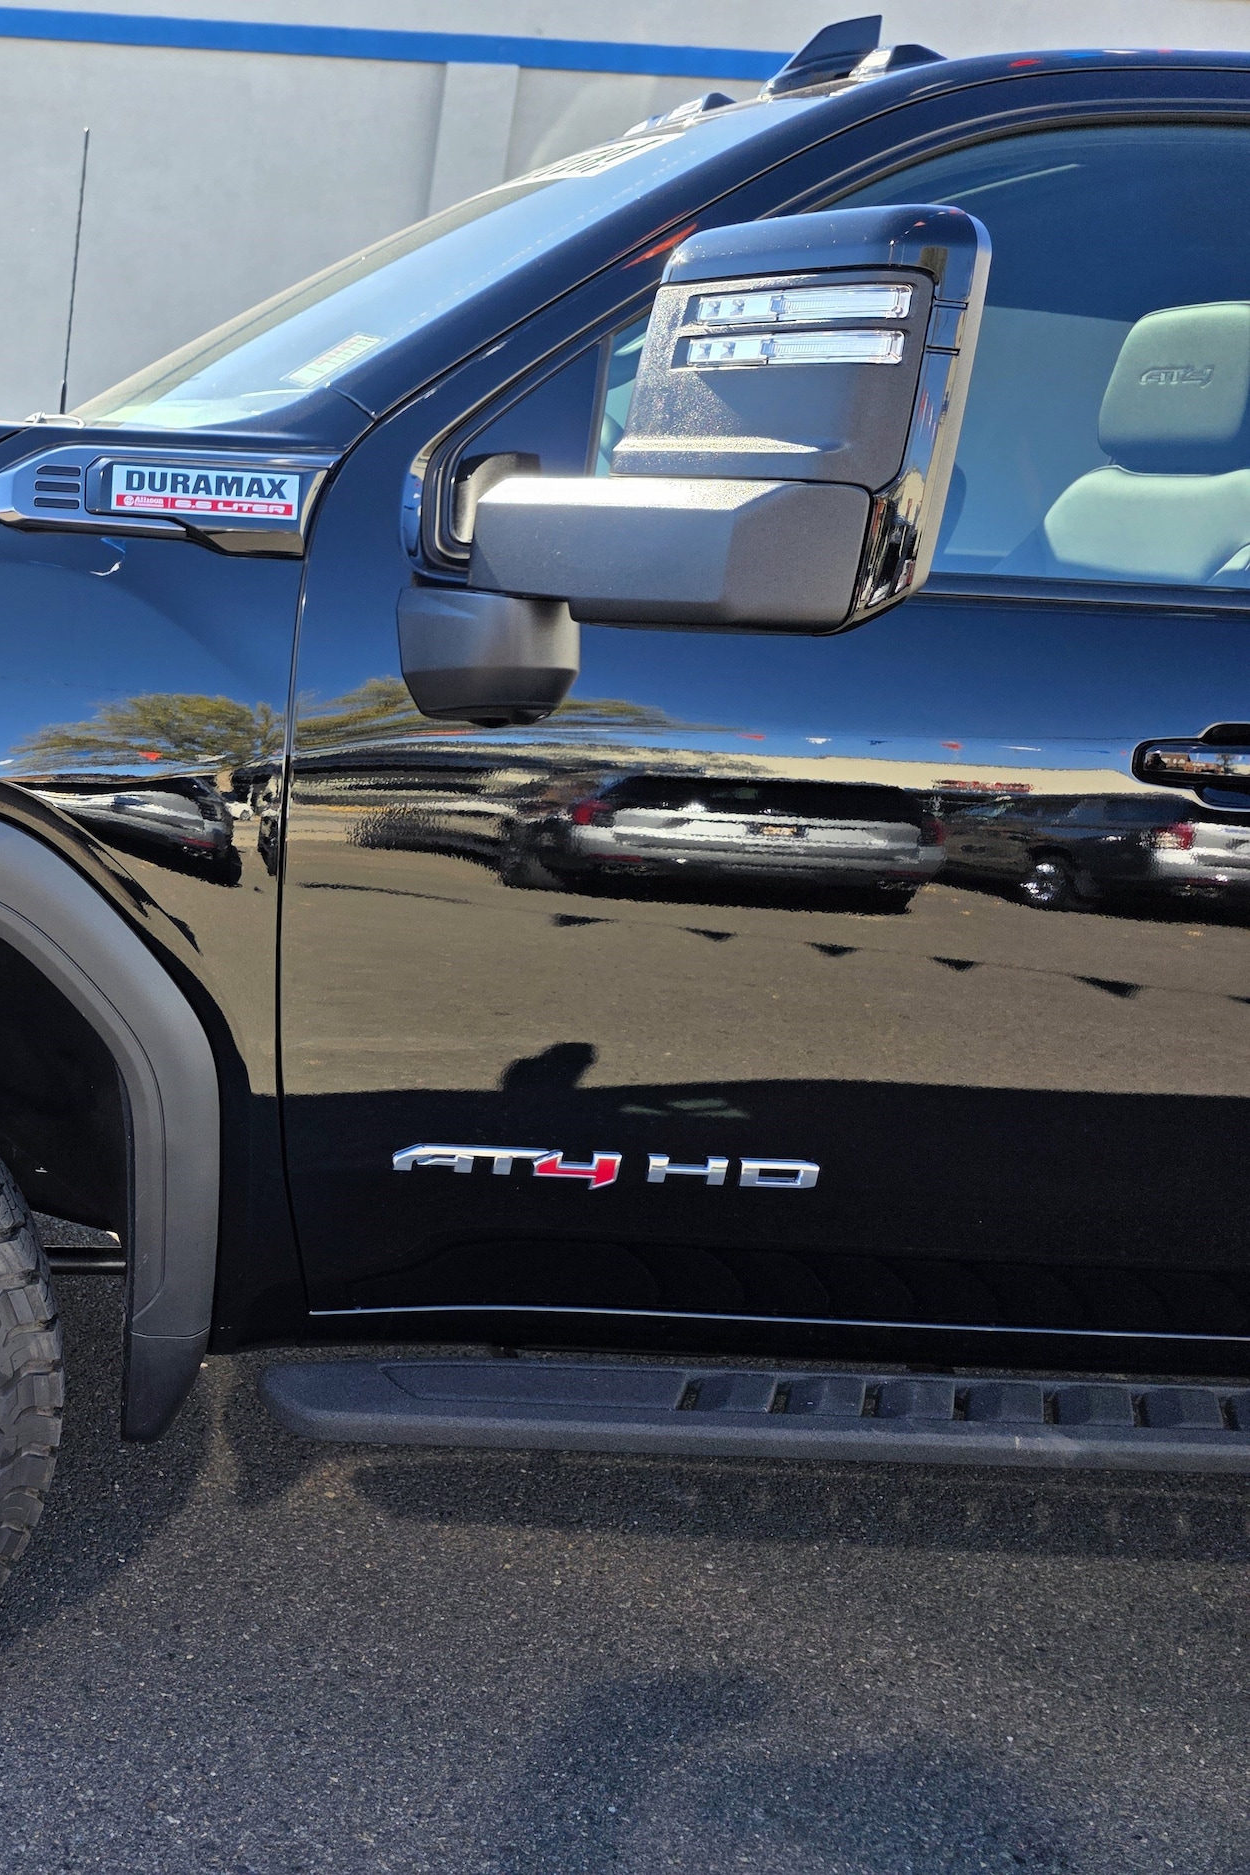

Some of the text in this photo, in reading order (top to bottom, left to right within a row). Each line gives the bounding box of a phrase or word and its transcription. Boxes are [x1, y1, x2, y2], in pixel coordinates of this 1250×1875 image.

[1139, 364, 1215, 388] AT4
[125, 470, 288, 499] DURAMAX
[175, 500, 213, 510] 6.6
[217, 502, 285, 514] LITER
[392, 1143, 821, 1190] AT4 HD
